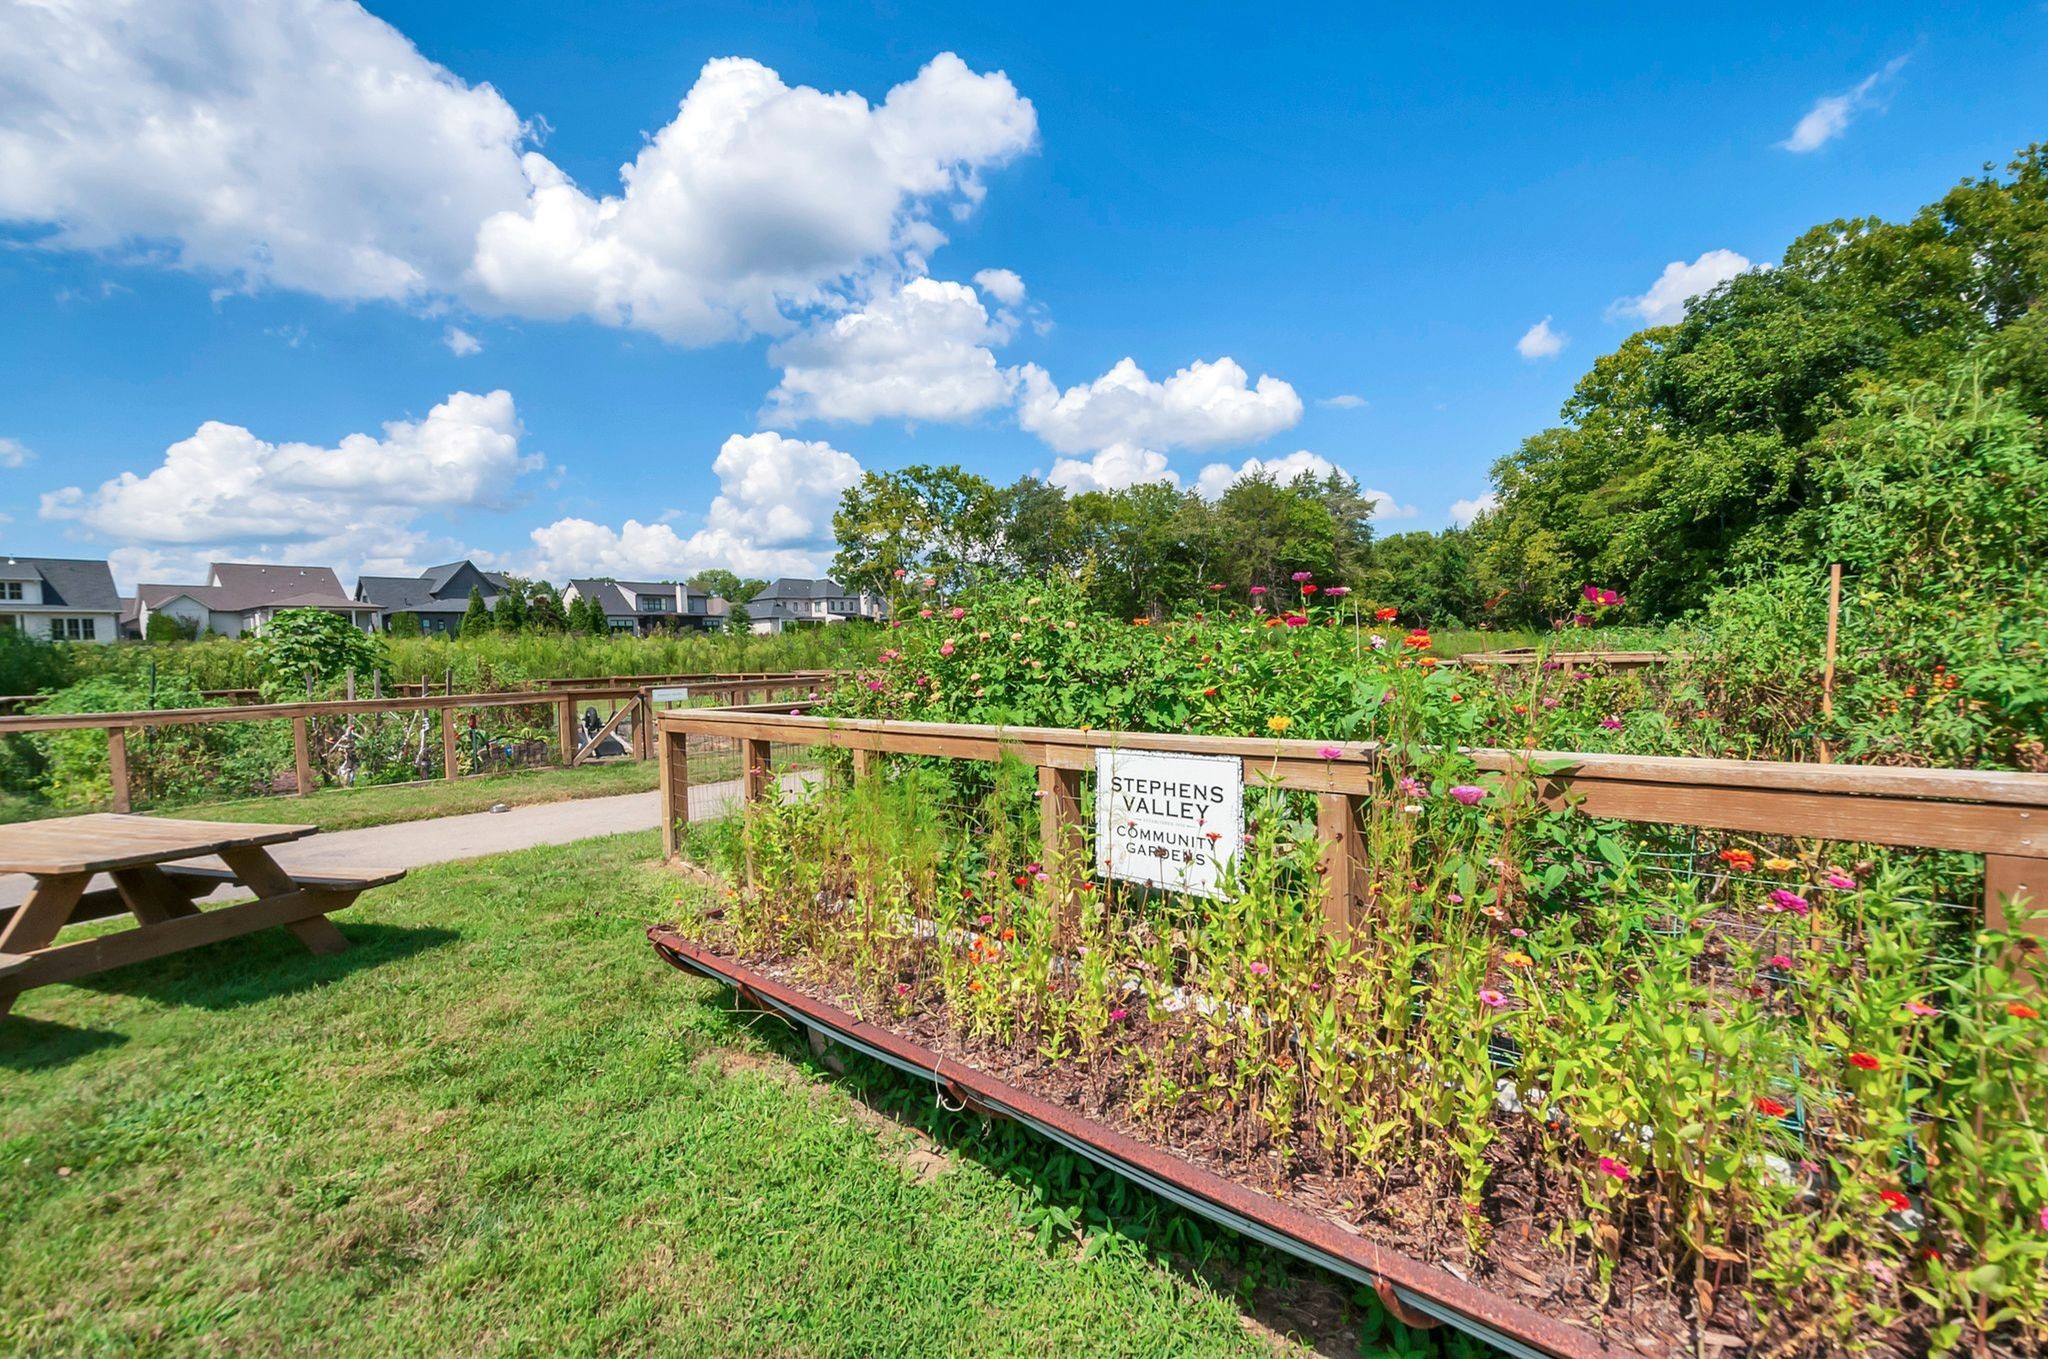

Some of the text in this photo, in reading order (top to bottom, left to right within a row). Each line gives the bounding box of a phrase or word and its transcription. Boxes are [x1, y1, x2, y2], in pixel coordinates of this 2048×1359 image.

[1111, 776, 1224, 804] STEPHENS
[1123, 796, 1209, 820] VALLEY
[1117, 825, 1217, 851] COMMUNITY
